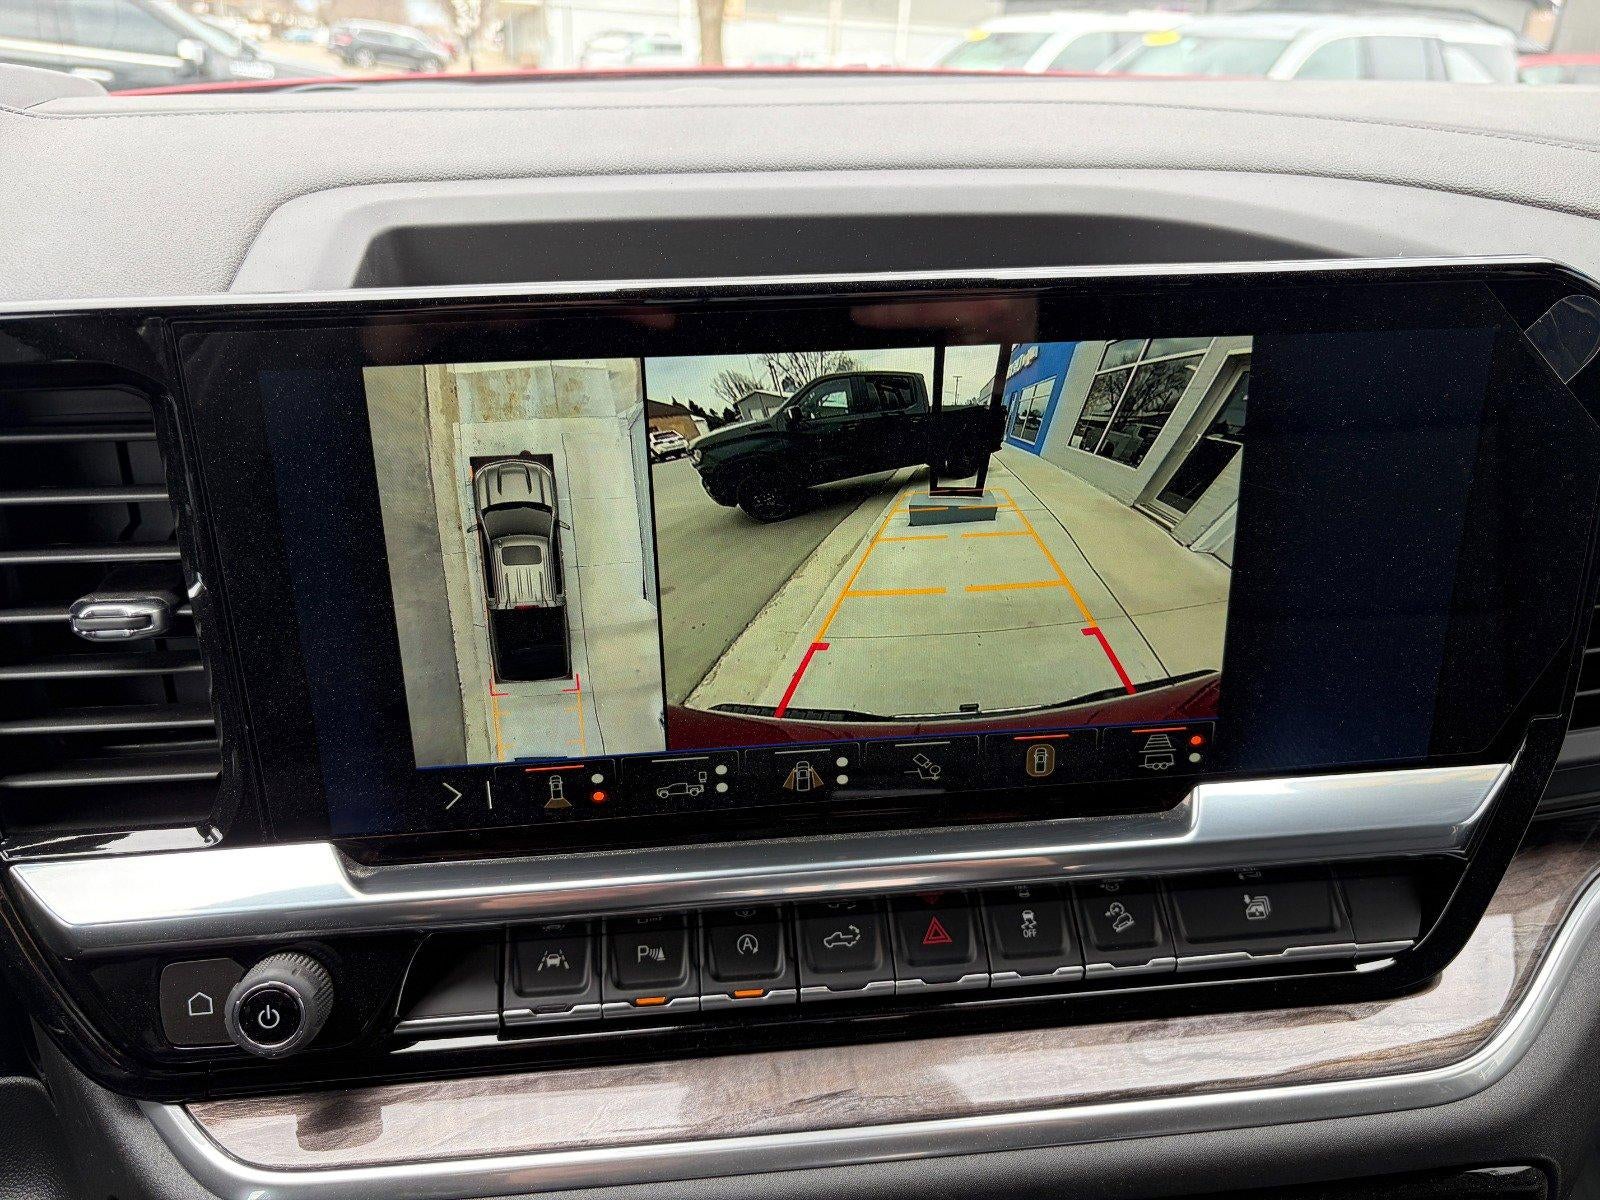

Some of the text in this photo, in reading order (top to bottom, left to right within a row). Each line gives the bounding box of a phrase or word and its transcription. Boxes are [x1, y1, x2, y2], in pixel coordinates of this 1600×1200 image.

[1023, 929, 1037, 938] OFF
[742, 937, 753, 951] A
[637, 945, 650, 963] P
